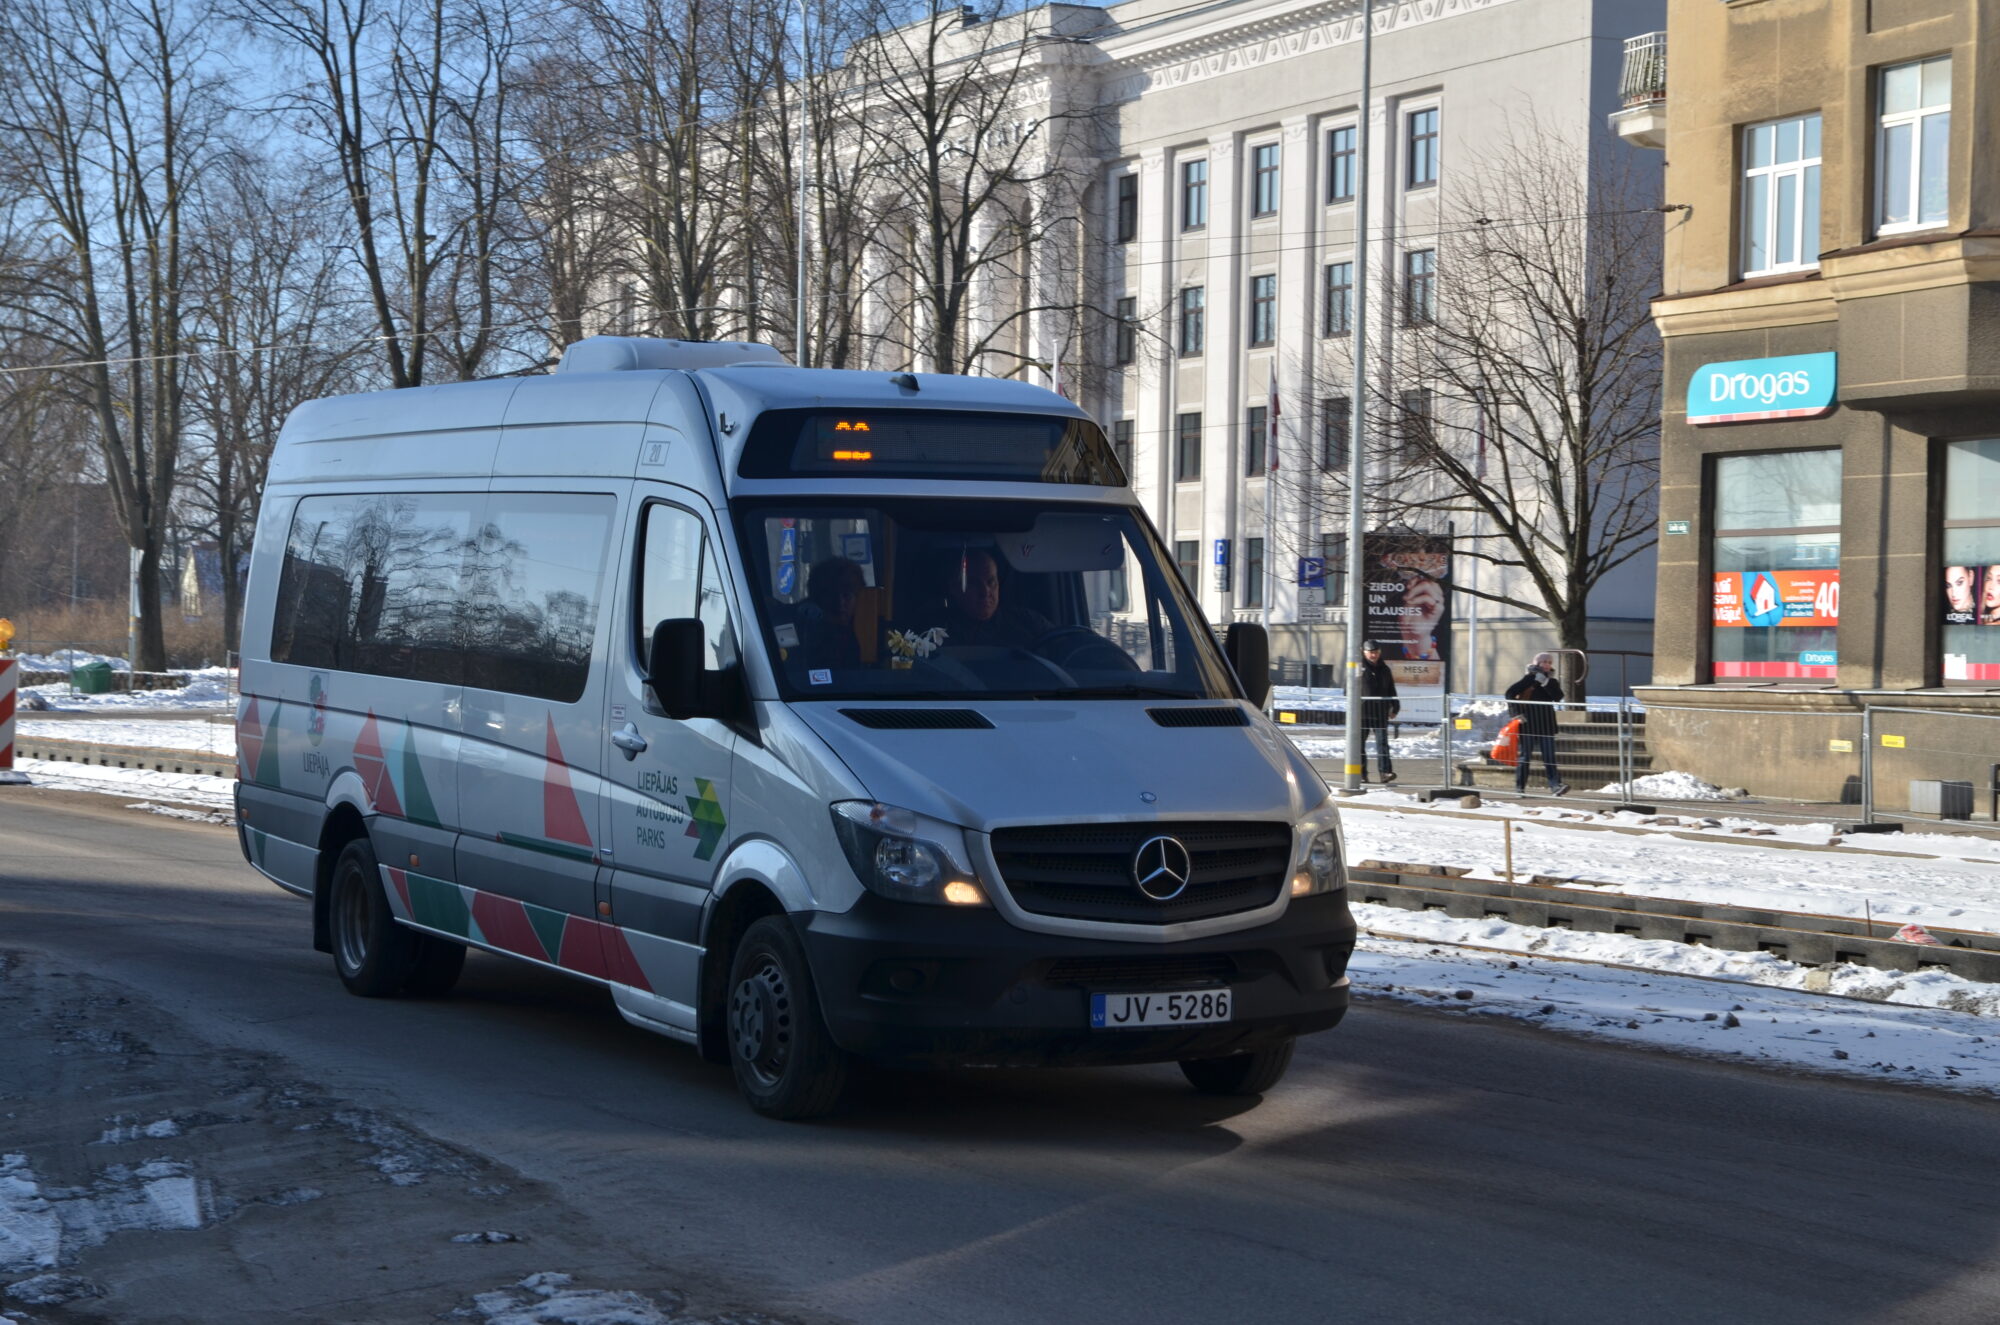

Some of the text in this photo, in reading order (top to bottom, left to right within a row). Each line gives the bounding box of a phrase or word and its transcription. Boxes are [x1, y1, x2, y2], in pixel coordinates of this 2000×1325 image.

[1710, 370, 1810, 404] Drogas
[1216, 542, 1225, 562] P
[1305, 561, 1320, 584] P
[1369, 582, 1405, 592] ZIEDO
[1369, 594, 1386, 603] UN
[1815, 581, 1839, 617] 40
[1368, 606, 1422, 616] KLAUSIES
[637, 770, 678, 796] LIEPĀJAS
[636, 799, 684, 825] AUTOBUSU
[636, 826, 665, 849] PARKS
[1093, 1013, 1104, 1021] LV
[1113, 993, 1228, 1022] JV-5286
